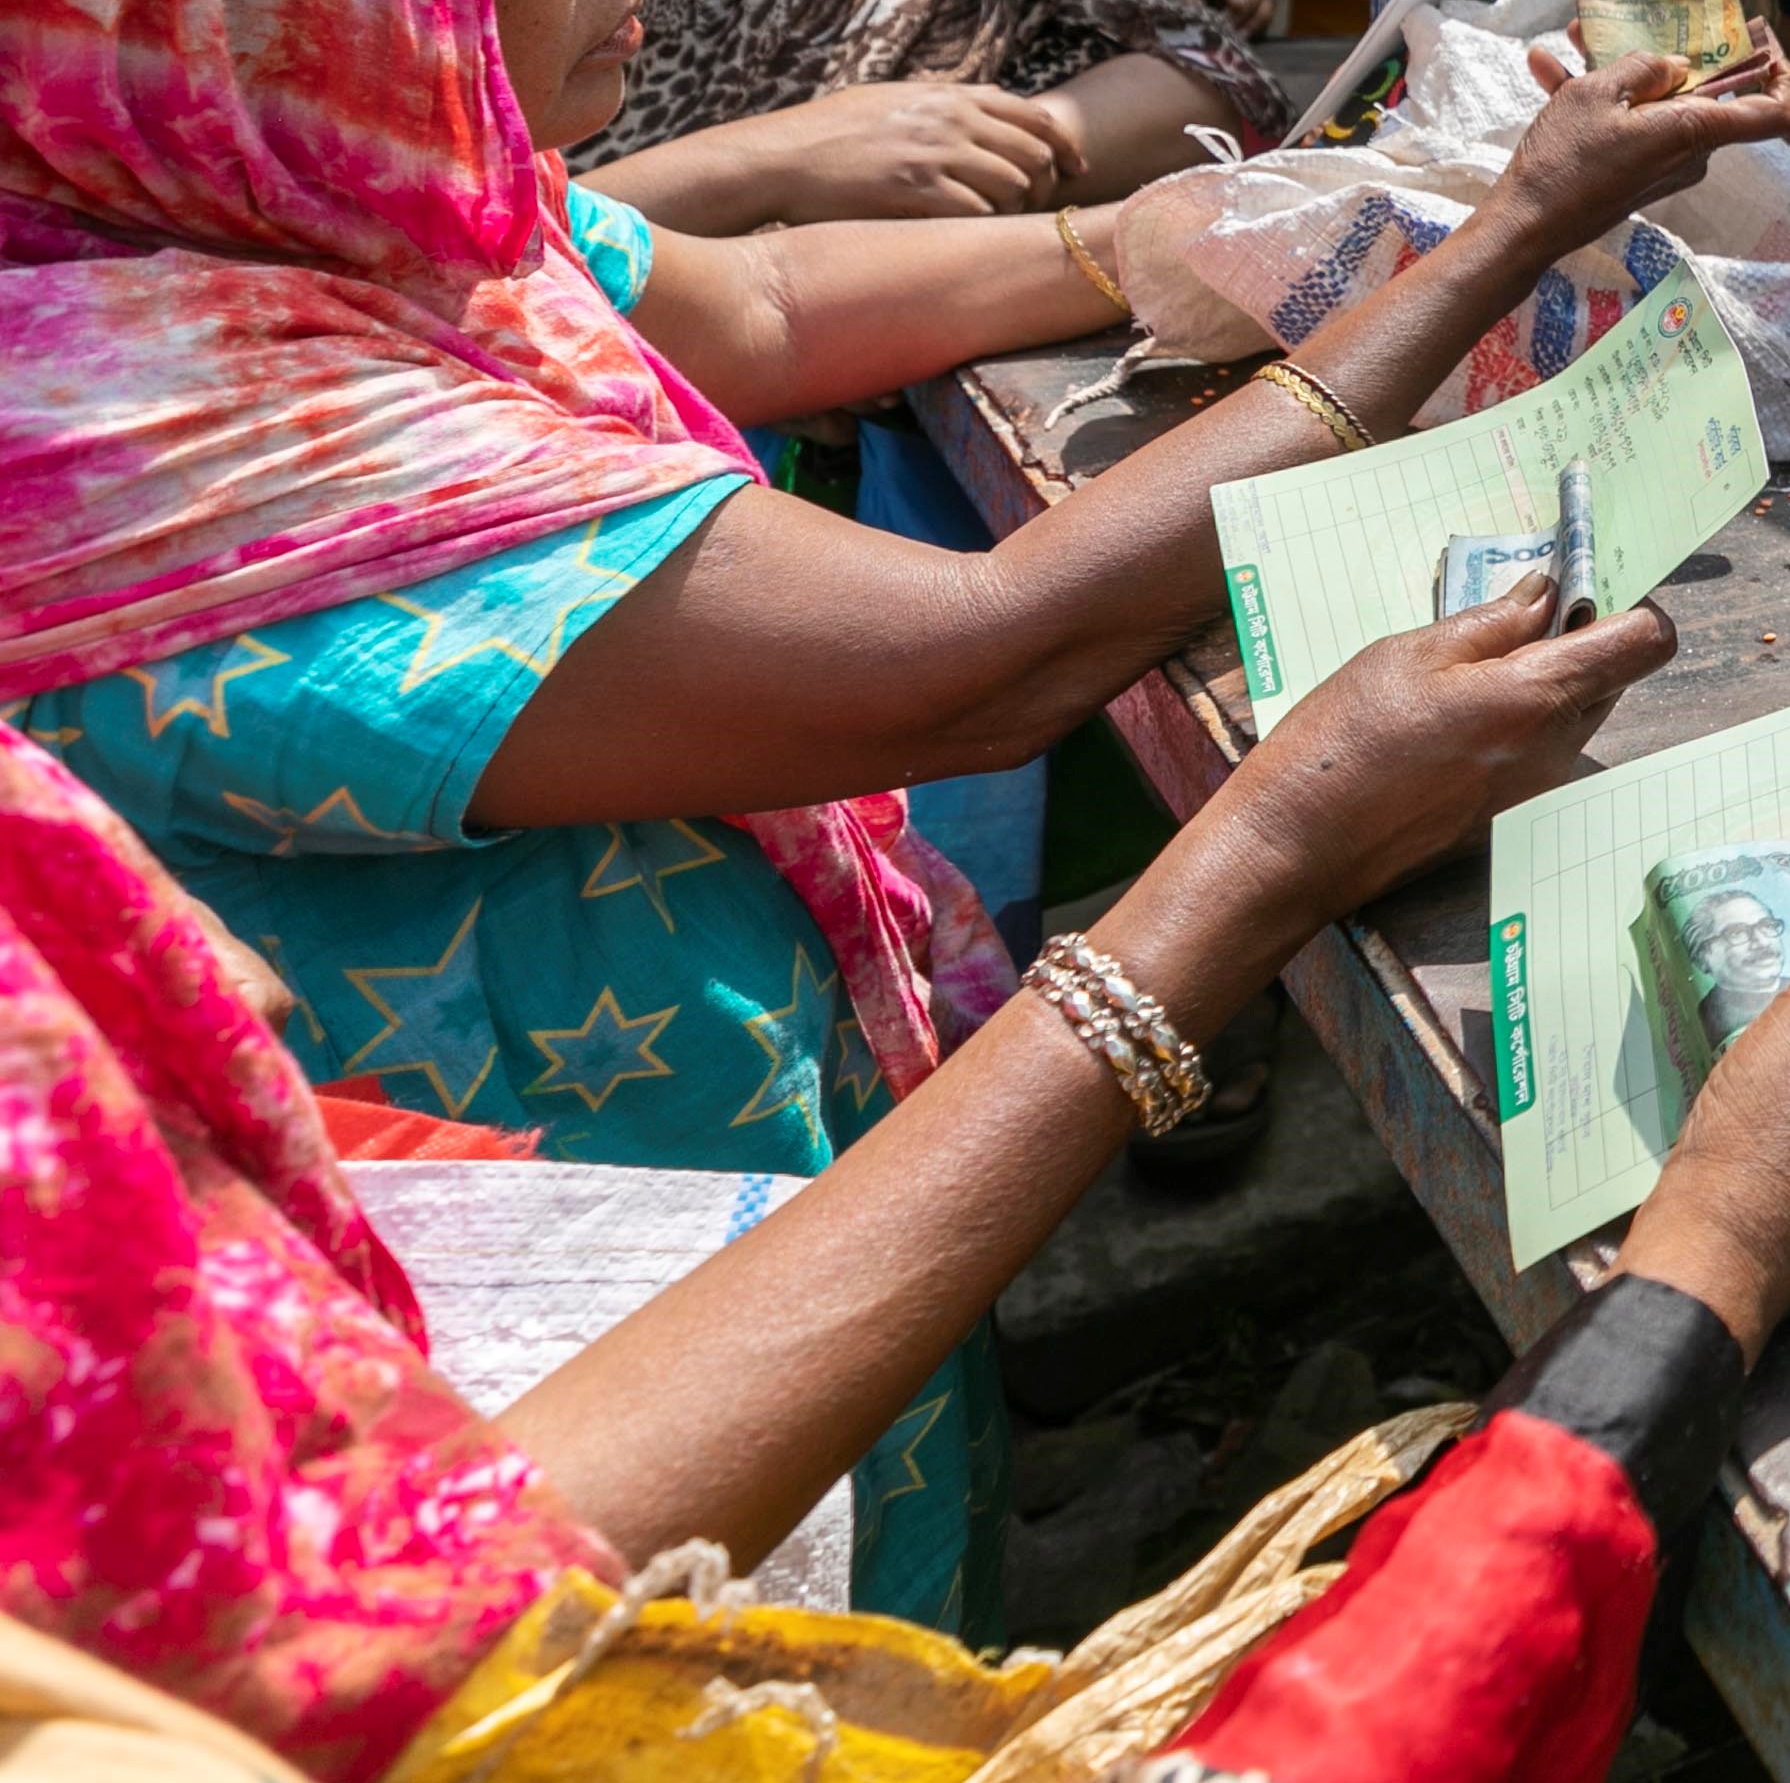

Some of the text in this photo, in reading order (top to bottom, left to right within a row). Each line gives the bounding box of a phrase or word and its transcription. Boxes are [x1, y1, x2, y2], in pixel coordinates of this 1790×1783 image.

[1504, 940, 1531, 1106] চট্টগ্রাম সিটি কর্পোরেশন
